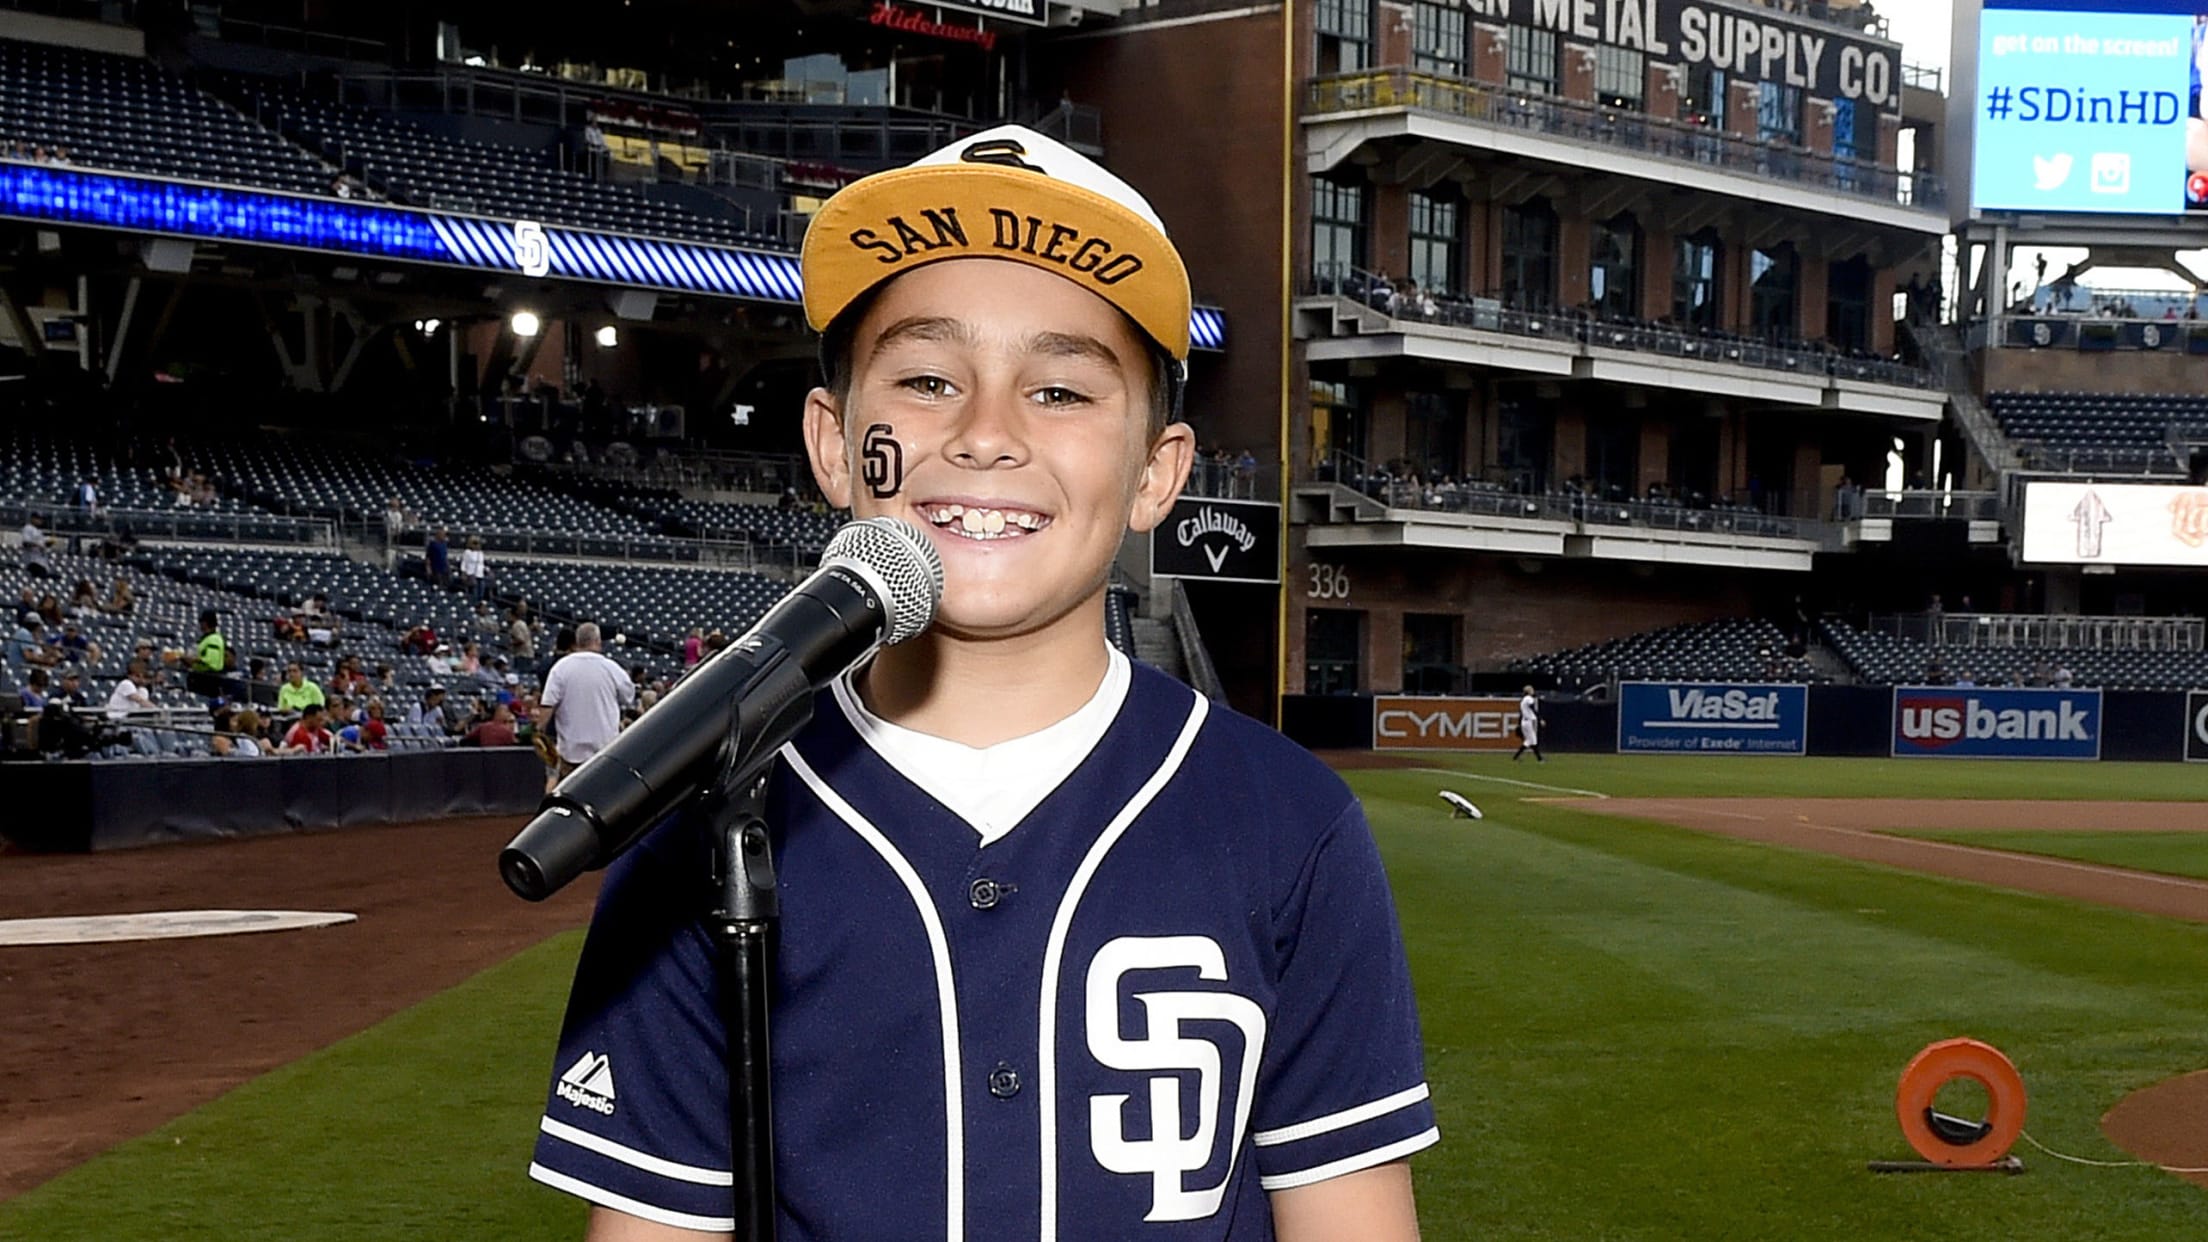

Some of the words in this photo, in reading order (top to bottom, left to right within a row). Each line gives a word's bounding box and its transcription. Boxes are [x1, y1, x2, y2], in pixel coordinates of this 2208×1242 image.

[870, 2, 996, 49] Hideaway
[1533, 0, 1668, 55] METAL
[1680, 6, 1825, 89] SUPPLY
[1839, 45, 1898, 107] CO.
[1993, 33, 2027, 57] get
[2032, 36, 2059, 53] on
[2063, 32, 2099, 56] the
[2103, 36, 2179, 57] screen!
[1987, 86, 2180, 125] #SDinHD
[849, 207, 969, 263] SAN
[989, 207, 1143, 286] DIEGO
[1177, 505, 1256, 552] Callaway
[1307, 563, 1349, 598] 336
[1668, 688, 1780, 721] ViaSat
[1628, 735, 1681, 749] Provider
[1684, 736, 1699, 749] of
[1747, 738, 1797, 751] Internet
[556, 1080, 615, 1115] Majestic
